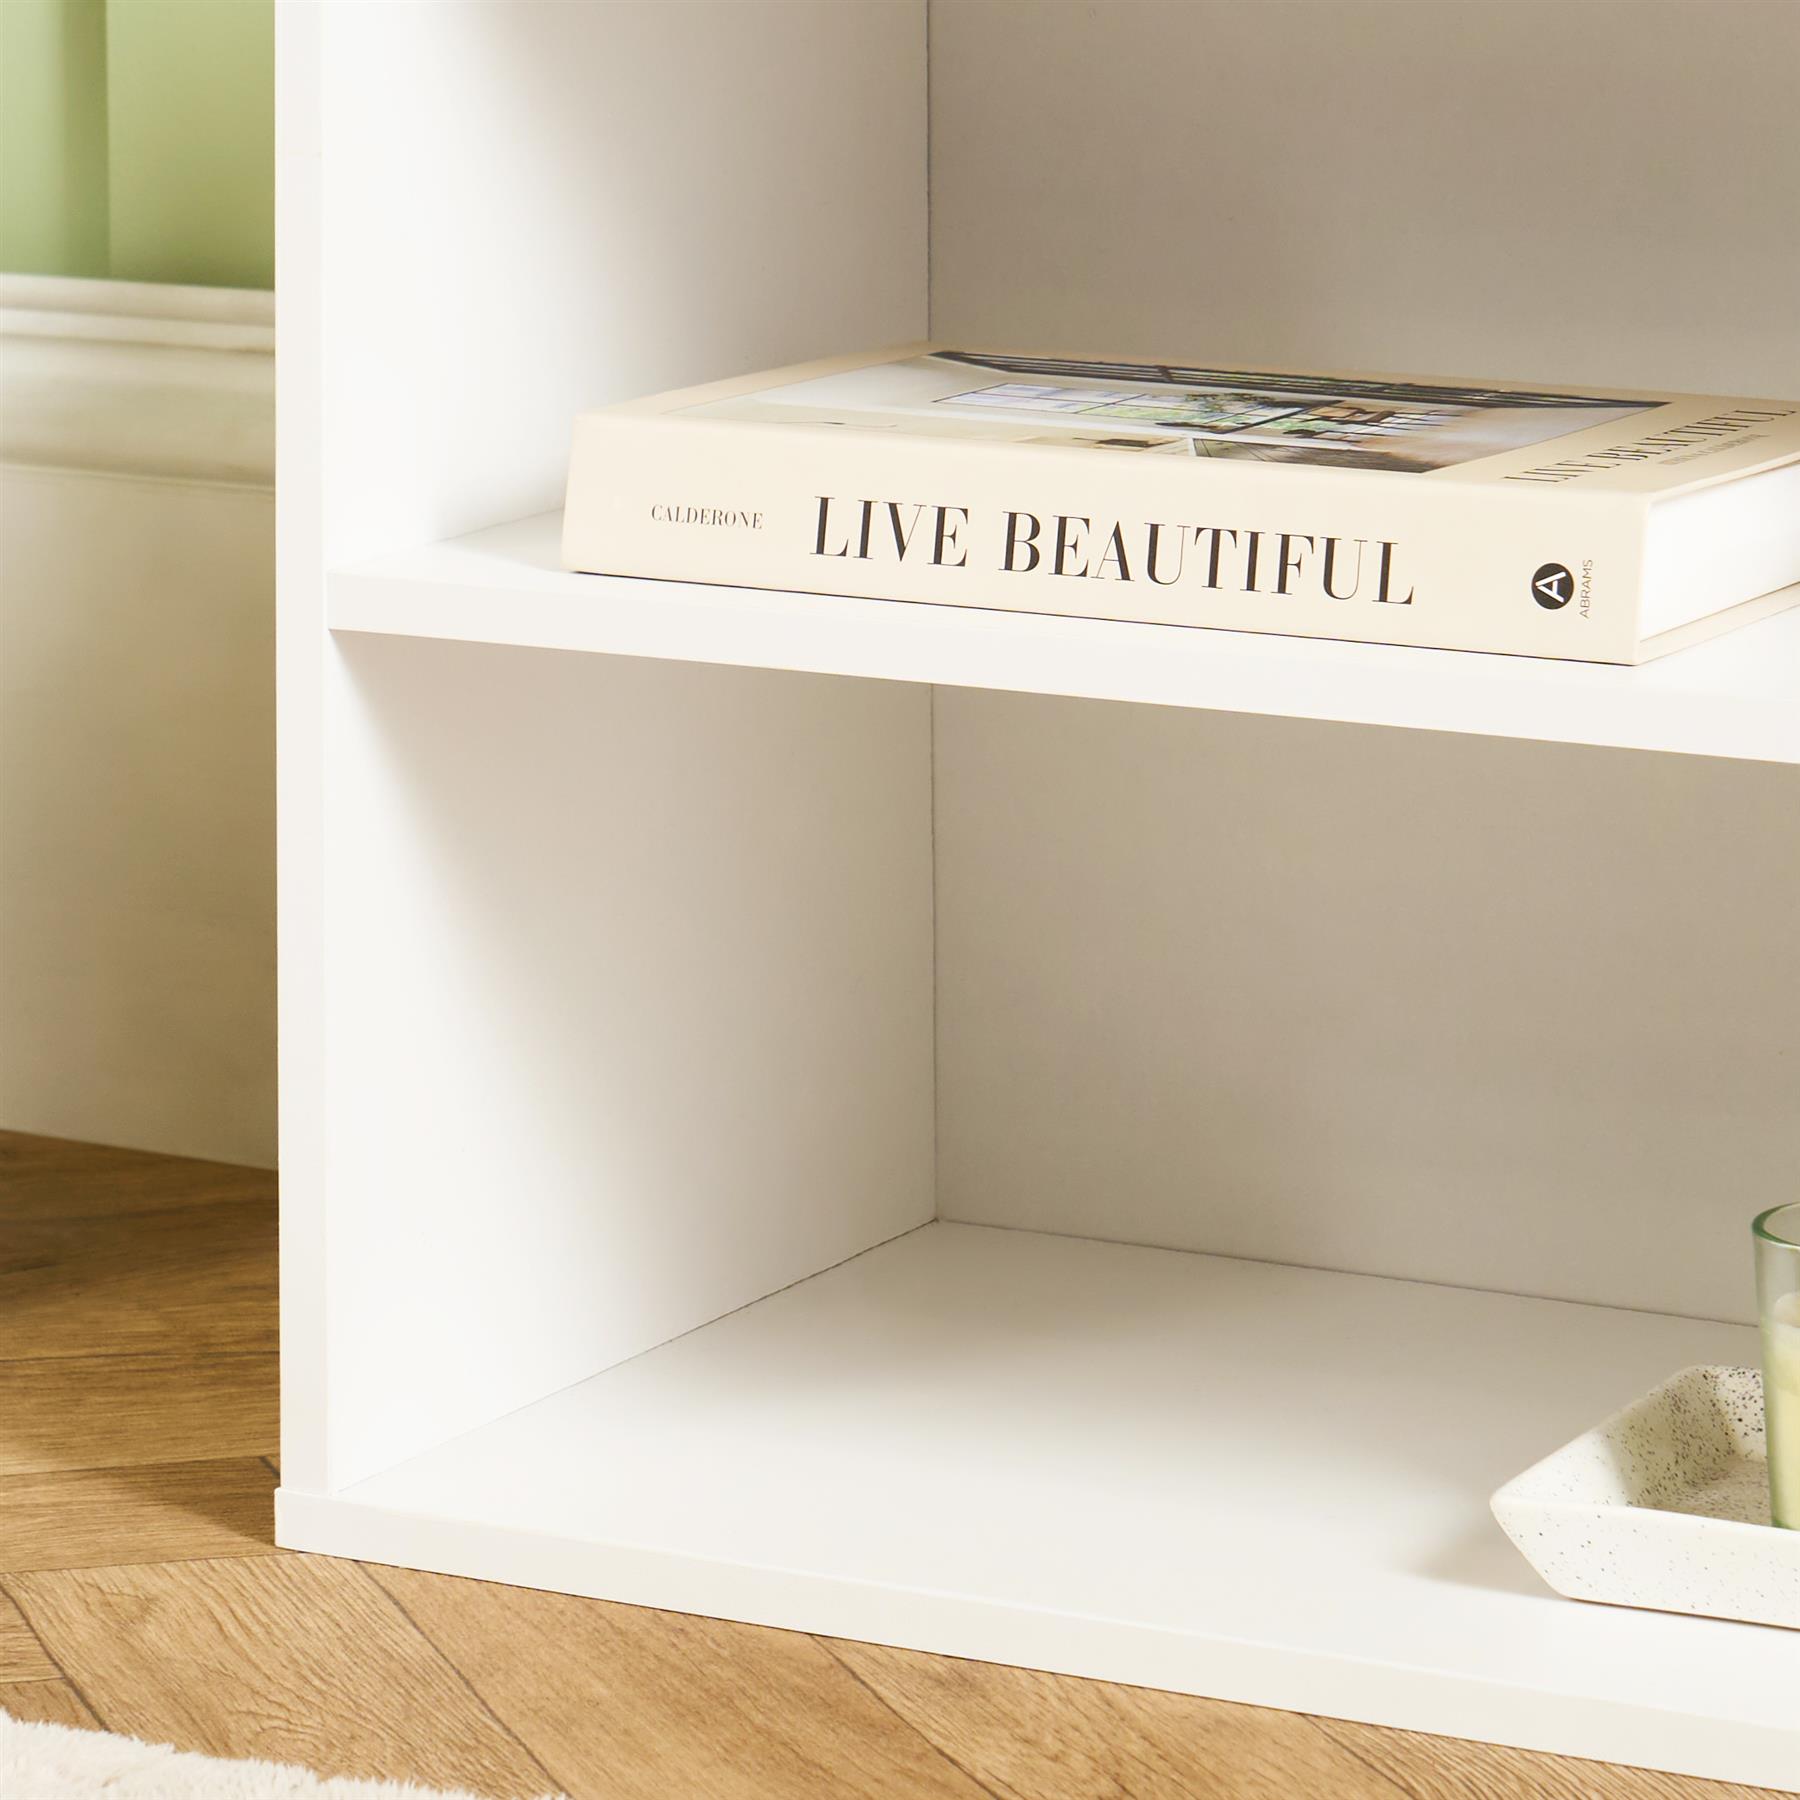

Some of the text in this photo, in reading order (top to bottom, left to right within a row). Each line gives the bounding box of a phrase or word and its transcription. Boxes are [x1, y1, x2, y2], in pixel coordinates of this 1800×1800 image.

[1503, 460, 1621, 483] LIVE
[1585, 410, 1796, 460] BEAUTIFUL
[651, 504, 763, 529] CALDERONE
[810, 496, 1414, 605] LIVE BEAUTIFUL
[1579, 559, 1593, 619] ABRAMS
